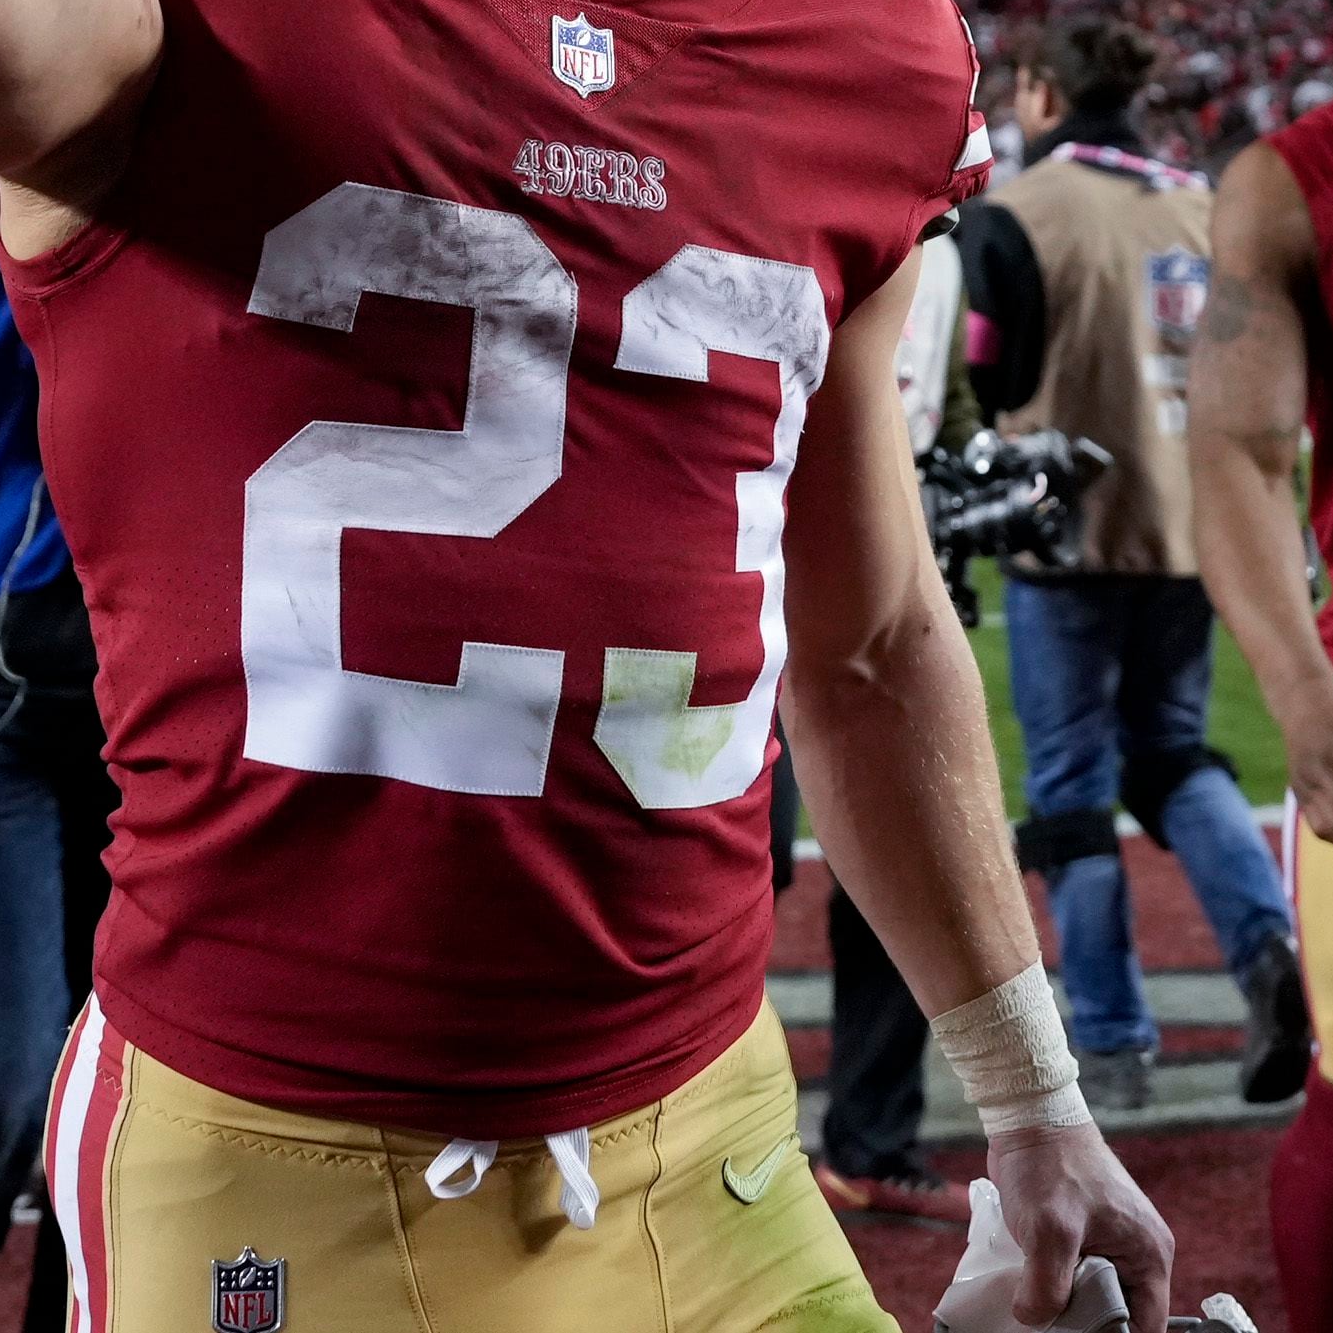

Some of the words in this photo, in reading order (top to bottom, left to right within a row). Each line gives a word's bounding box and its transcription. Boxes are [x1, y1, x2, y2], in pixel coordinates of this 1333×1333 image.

[563, 47, 604, 80] NFL
[511, 138, 668, 211] 49ERS
[242, 181, 830, 809] 23
[223, 1292, 272, 1329] NFL
